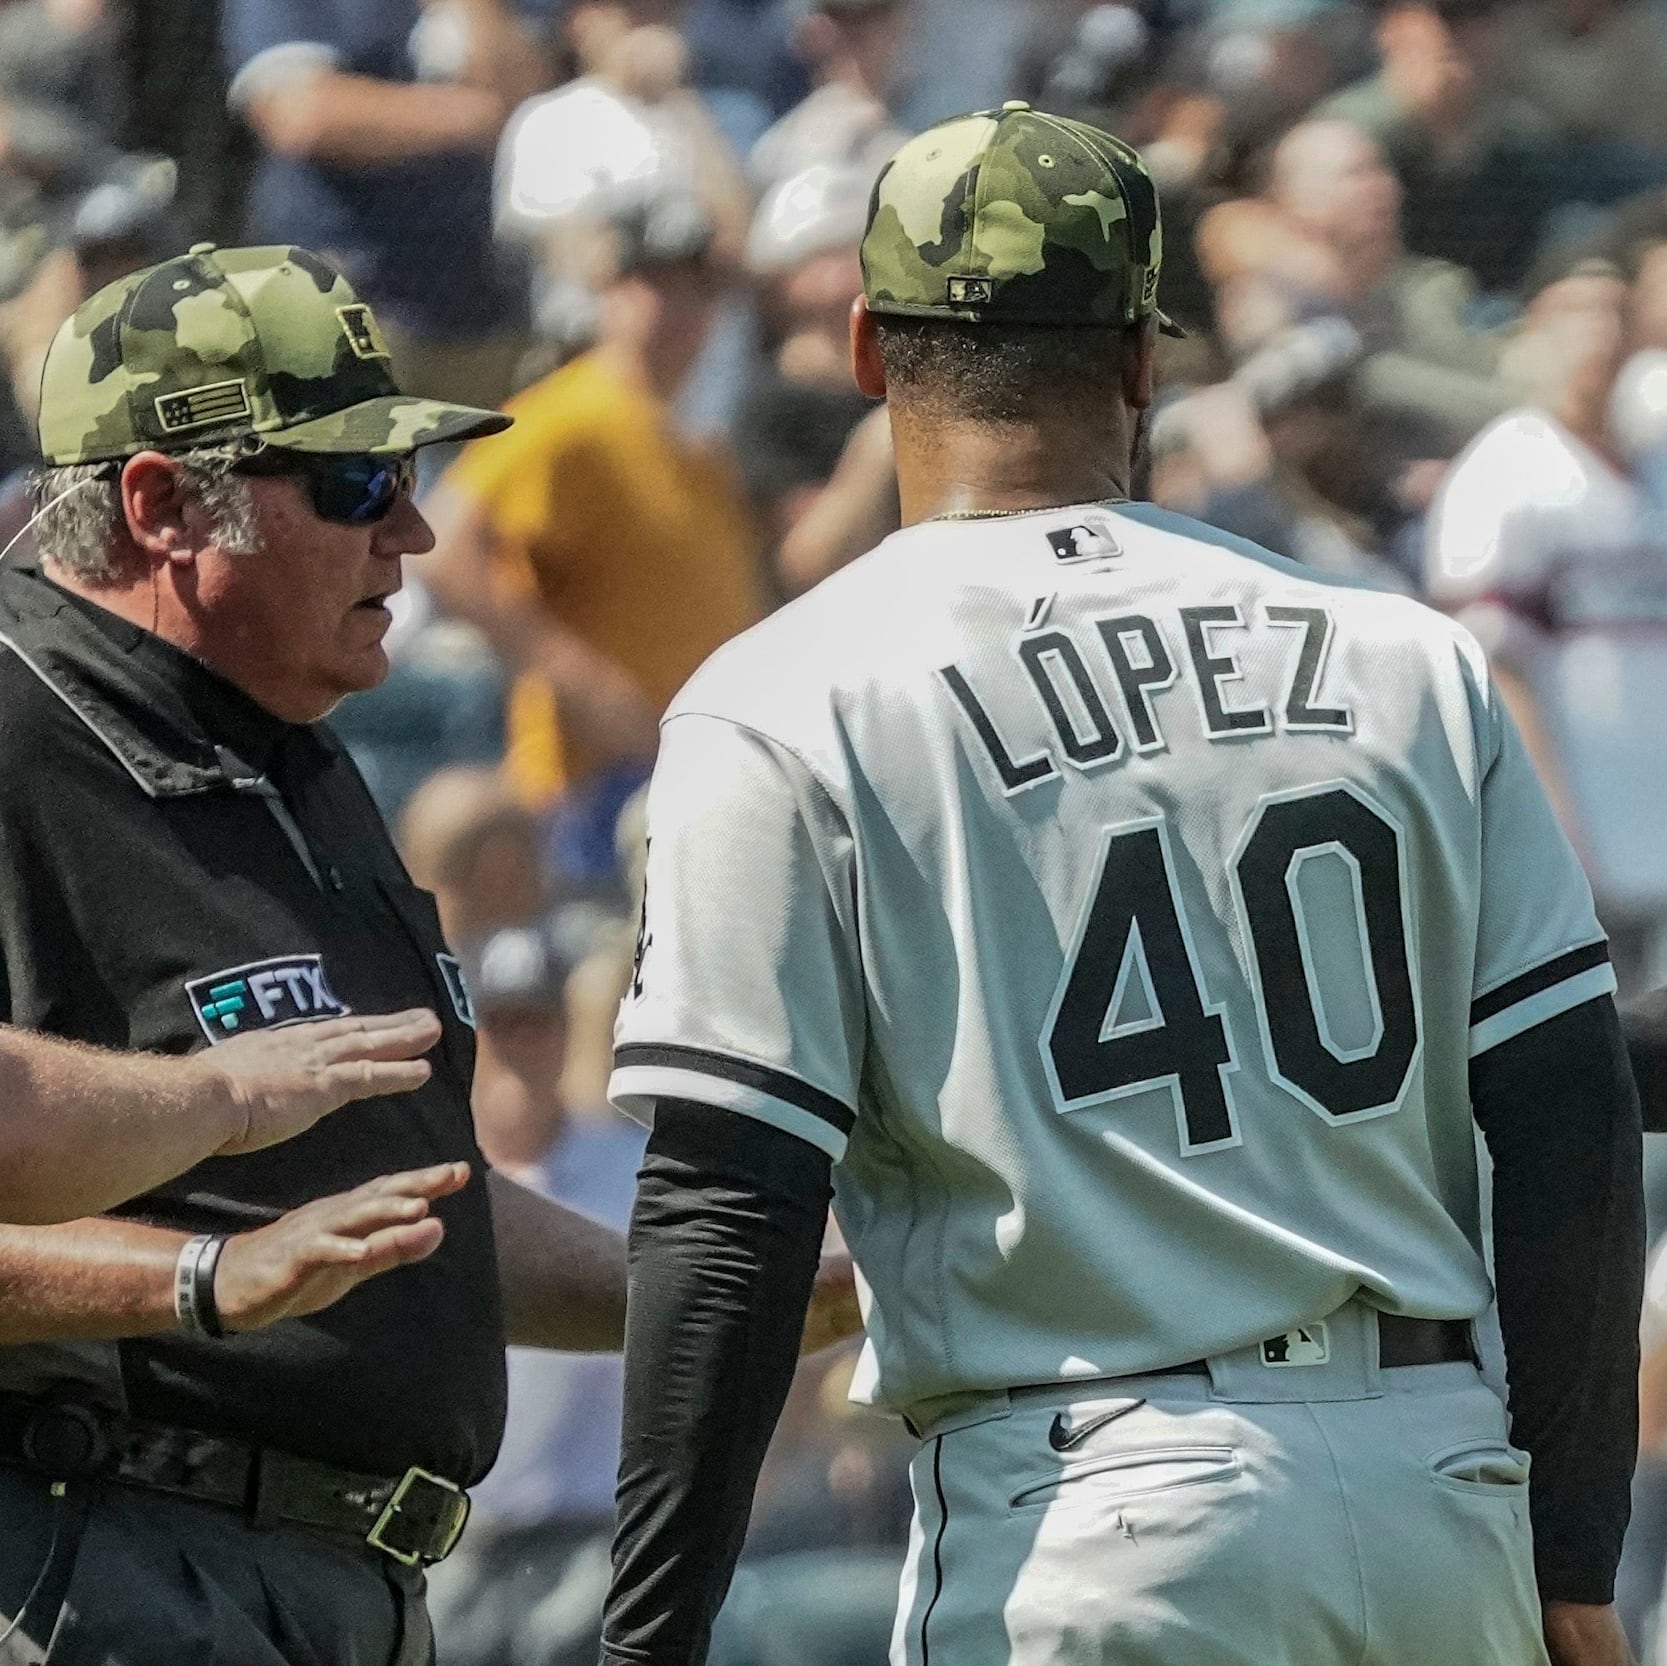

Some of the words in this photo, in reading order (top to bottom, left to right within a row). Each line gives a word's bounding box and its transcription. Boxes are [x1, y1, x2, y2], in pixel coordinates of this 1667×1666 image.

[936, 591, 1355, 798] LÓPEZ
[247, 966, 342, 1020] FTX
[1039, 778, 1424, 1158] 40
